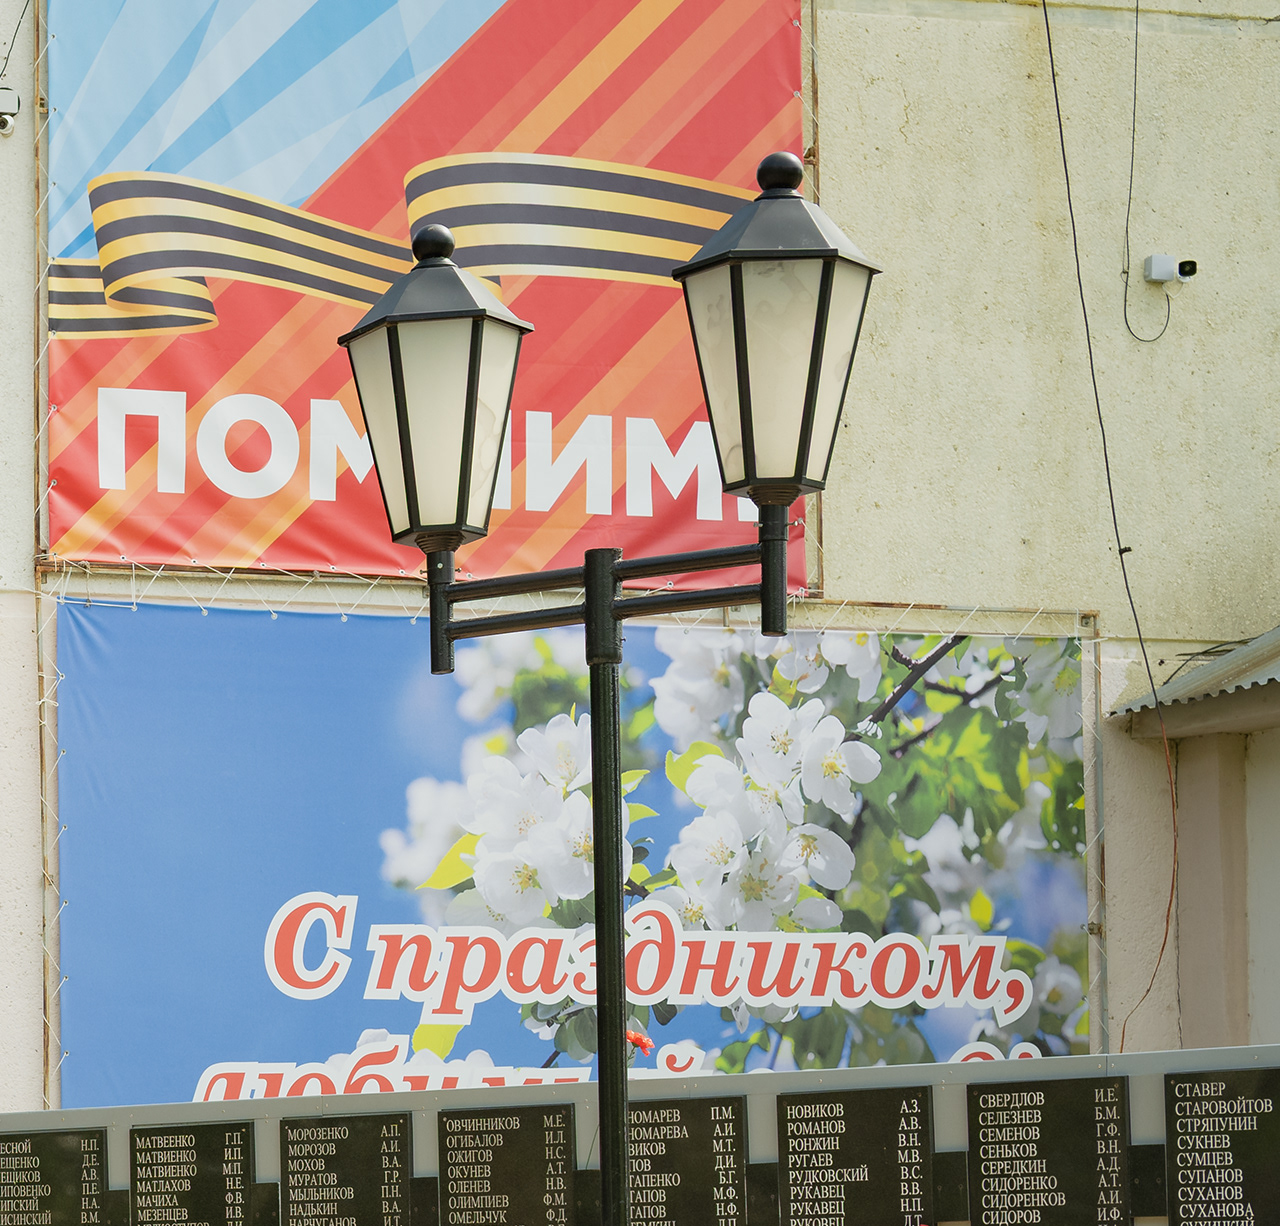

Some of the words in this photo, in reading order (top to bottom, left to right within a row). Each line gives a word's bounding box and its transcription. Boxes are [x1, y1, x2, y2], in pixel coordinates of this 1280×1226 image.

[97, 386, 759, 522] ПОМИМ
[269, 896, 354, 996] С
[710, 1106, 736, 1120] П.М.
[786, 1103, 845, 1119] НОВИКОВ
[899, 1099, 921, 1113] А.З.
[978, 1109, 1043, 1125] СЕЛЕЗНЕВ
[1094, 1106, 1121, 1120] Б.М.
[713, 1123, 737, 1136] А.И.
[786, 1120, 847, 1136] РОМАНОВ
[898, 1116, 922, 1130] А.В.
[978, 1126, 1041, 1142] СЕМЕНОВ
[1095, 1123, 1121, 1137] Г.Ф.
[1176, 1116, 1258, 1133] СТРЯПУНИН
[287, 1143, 337, 1156] МОРОЗОВ
[380, 1140, 401, 1153] А.И.
[446, 1134, 504, 1148] ОГИБАЛОВ
[544, 1131, 567, 1144] И.Л.
[787, 1136, 840, 1152] РОНЖИН
[897, 1133, 922, 1147] В.Н.
[1176, 1134, 1231, 1150] СУКНЕВ
[136, 1150, 197, 1164] МАТВИЕНКО
[223, 1148, 244, 1160] И.П.
[287, 1158, 326, 1172] МОХОВ
[381, 1156, 402, 1168] В.А.
[787, 1153, 834, 1168] РУГАЕВ
[896, 1149, 923, 1163] М.В.
[447, 1165, 492, 1179] ОКУНЕВ
[545, 1162, 567, 1174] А.Т.
[1177, 1168, 1244, 1184] СУПАНОВ
[81, 1183, 100, 1195] П.Е.
[448, 1195, 510, 1209] ОЛИМПИЕВ
[542, 1193, 568, 1206] Ф.М.
